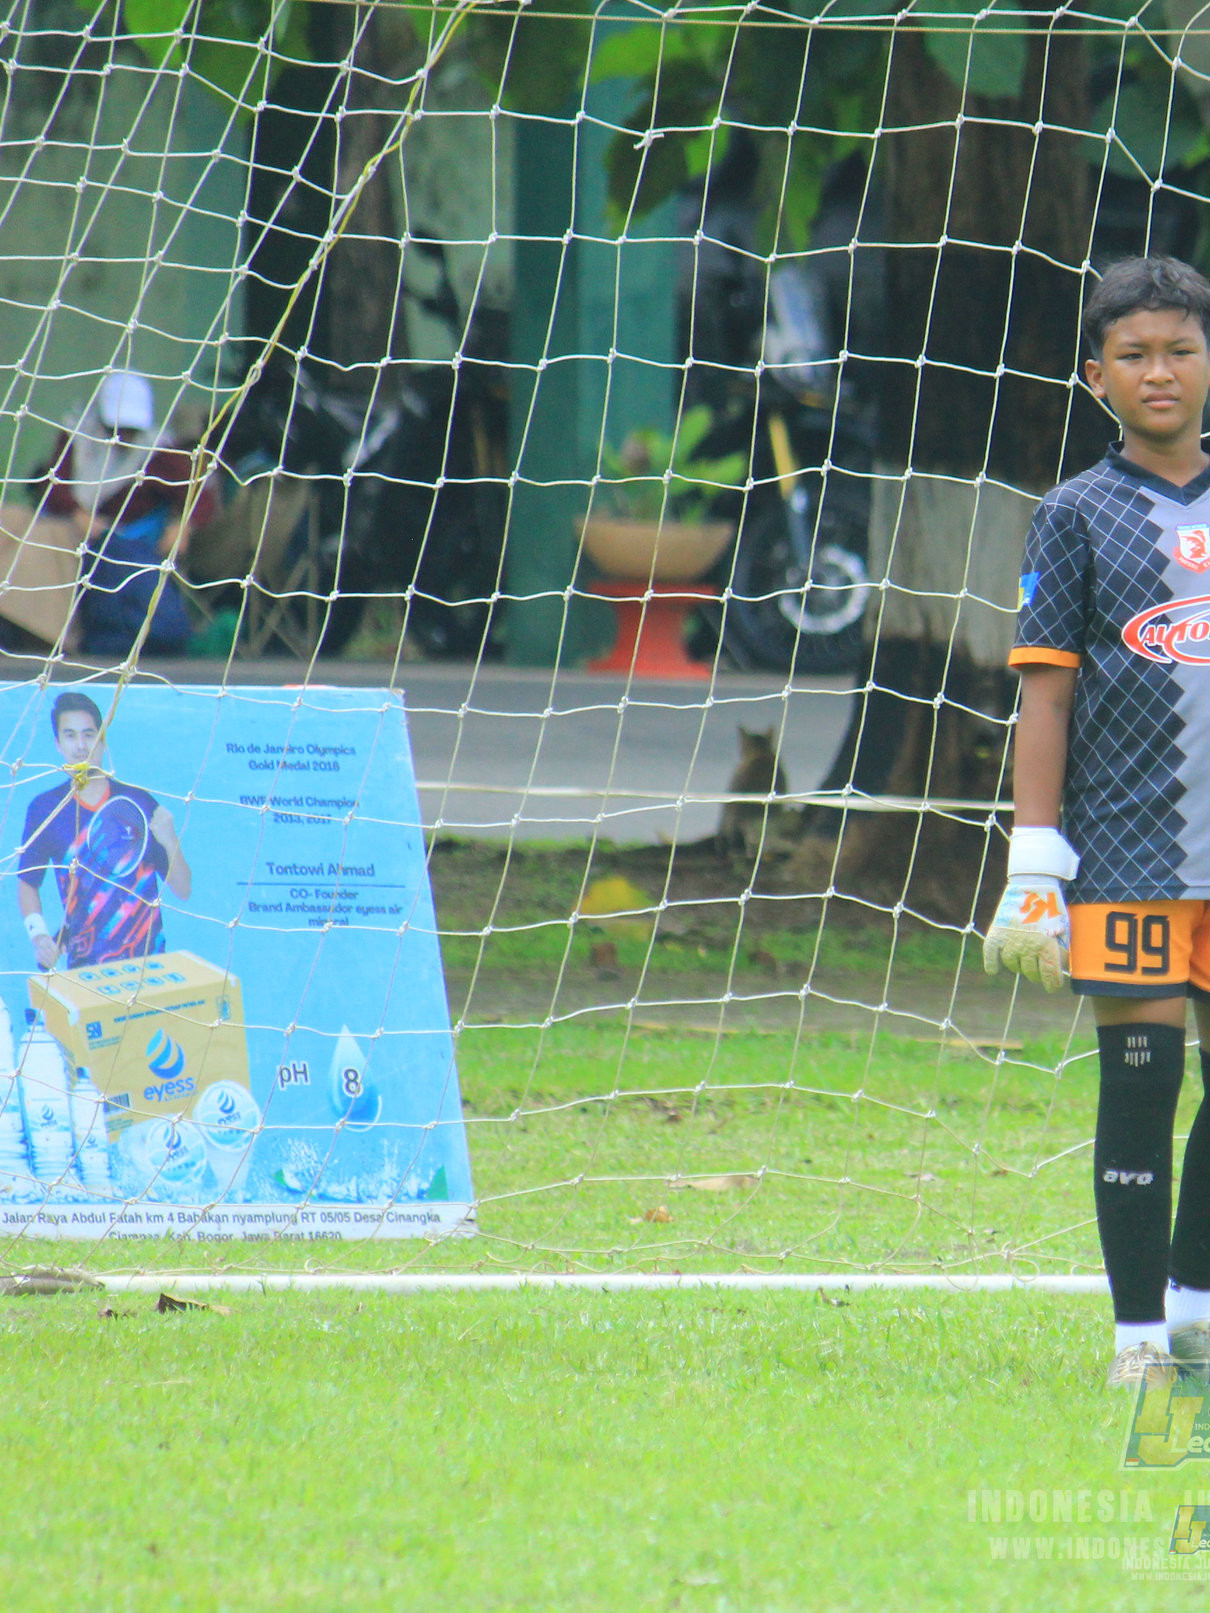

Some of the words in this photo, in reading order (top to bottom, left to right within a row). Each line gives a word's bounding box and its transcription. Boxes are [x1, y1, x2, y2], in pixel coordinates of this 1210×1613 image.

[226, 743, 245, 754] Rio
[247, 743, 261, 754] de
[306, 743, 357, 757] Olympics
[248, 760, 275, 771] Gold
[277, 760, 311, 771] Medal
[270, 796, 304, 807] World
[305, 796, 360, 809] Champion
[266, 862, 325, 876] Tontowi
[327, 863, 376, 877] Ahmad
[315, 889, 359, 900] Founder
[248, 902, 282, 913] Brand
[388, 903, 403, 915] air
[1104, 911, 1170, 975] 99
[279, 1063, 308, 1089] pH
[343, 1068, 361, 1095] 8
[143, 1076, 195, 1102] eyess
[2, 1212, 33, 1224] Jalan
[38, 1212, 68, 1226] Raya
[71, 1211, 106, 1224] Abdul
[109, 1211, 143, 1224] Fatah
[146, 1211, 164, 1224] km
[167, 1212, 175, 1224] 4
[232, 1211, 298, 1226] nyamplung
[301, 1212, 318, 1224] RT
[320, 1211, 351, 1224] 05/05
[386, 1211, 441, 1226] Cinangka
